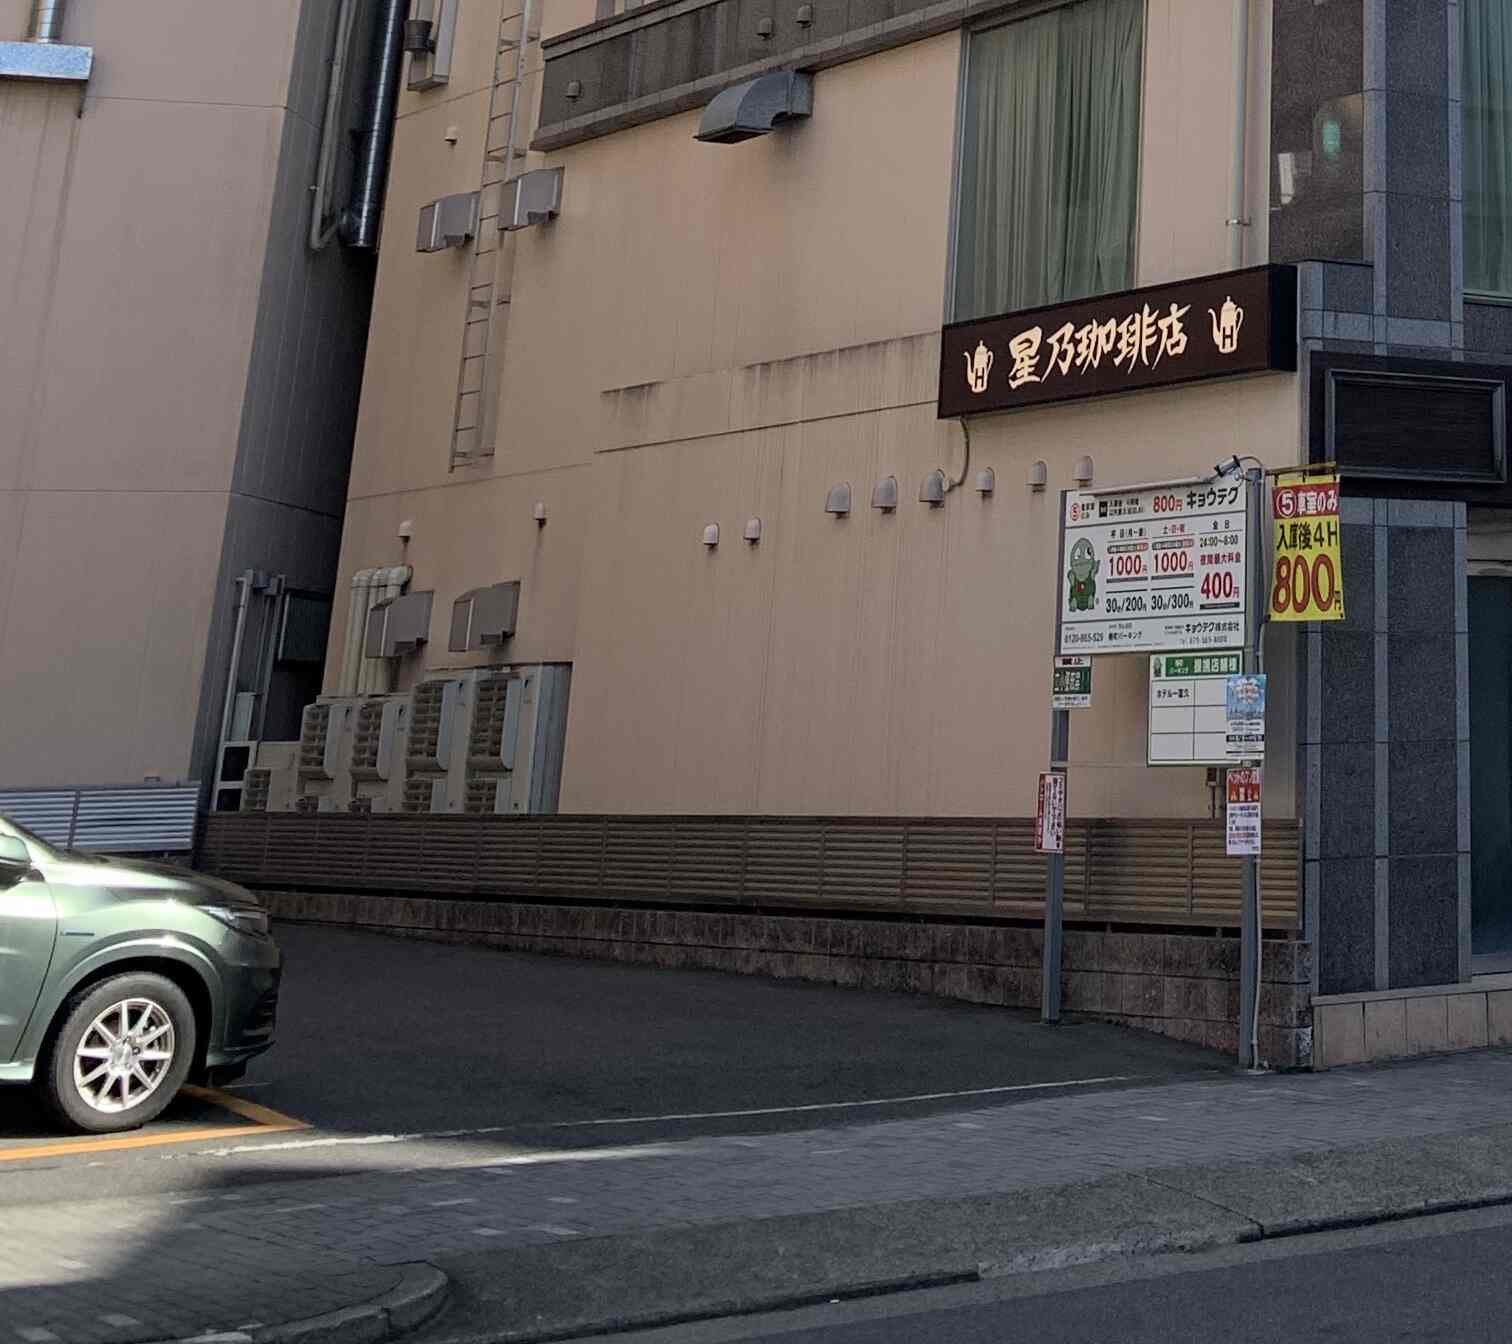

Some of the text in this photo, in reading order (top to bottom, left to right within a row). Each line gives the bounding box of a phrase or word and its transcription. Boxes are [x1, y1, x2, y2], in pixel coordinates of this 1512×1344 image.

[1007, 302, 1192, 391] 星乃珈琲店
[1152, 494, 1183, 513] 800円
[1186, 486, 1240, 510] キョウテク
[1200, 571, 1240, 599] 400円
[1272, 553, 1342, 614] 800円
